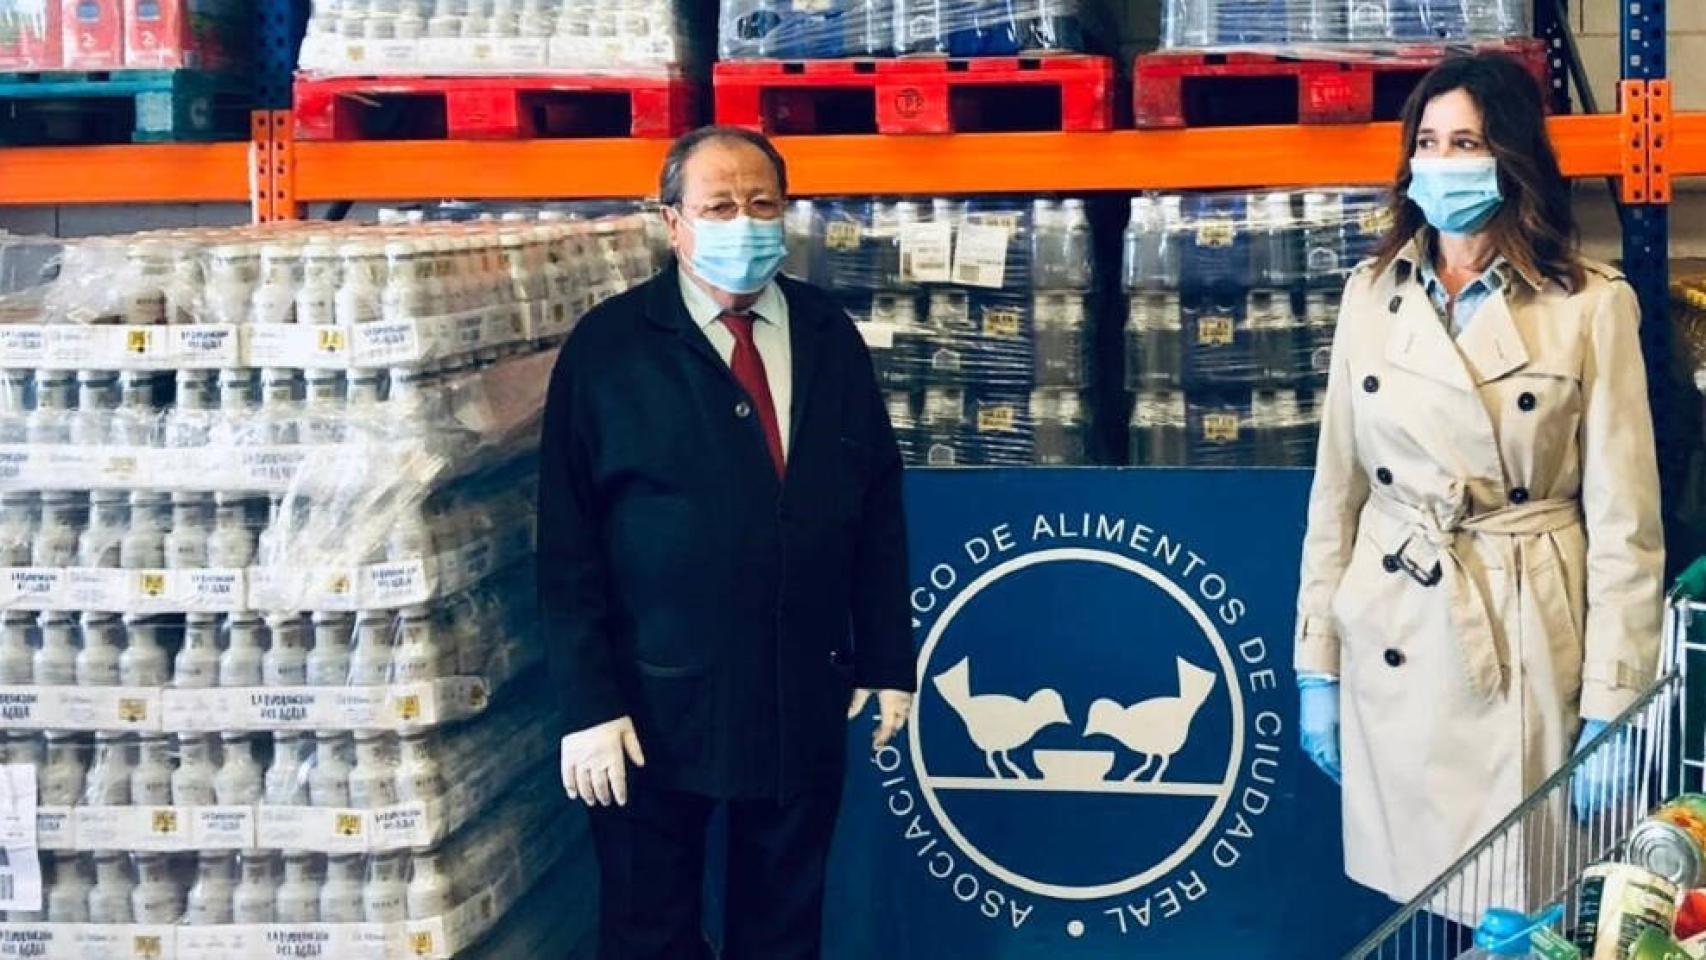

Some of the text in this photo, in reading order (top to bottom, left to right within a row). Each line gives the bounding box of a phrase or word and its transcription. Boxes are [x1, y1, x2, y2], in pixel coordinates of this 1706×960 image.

[965, 524, 1015, 563] DE
[1033, 513, 1245, 624] ALIMENTOS
[1240, 637, 1276, 691] DE
[870, 714, 1032, 927] ASOCIACIÓ
[1214, 712, 1281, 867] CIUDAD
[1105, 871, 1207, 932] REAL
